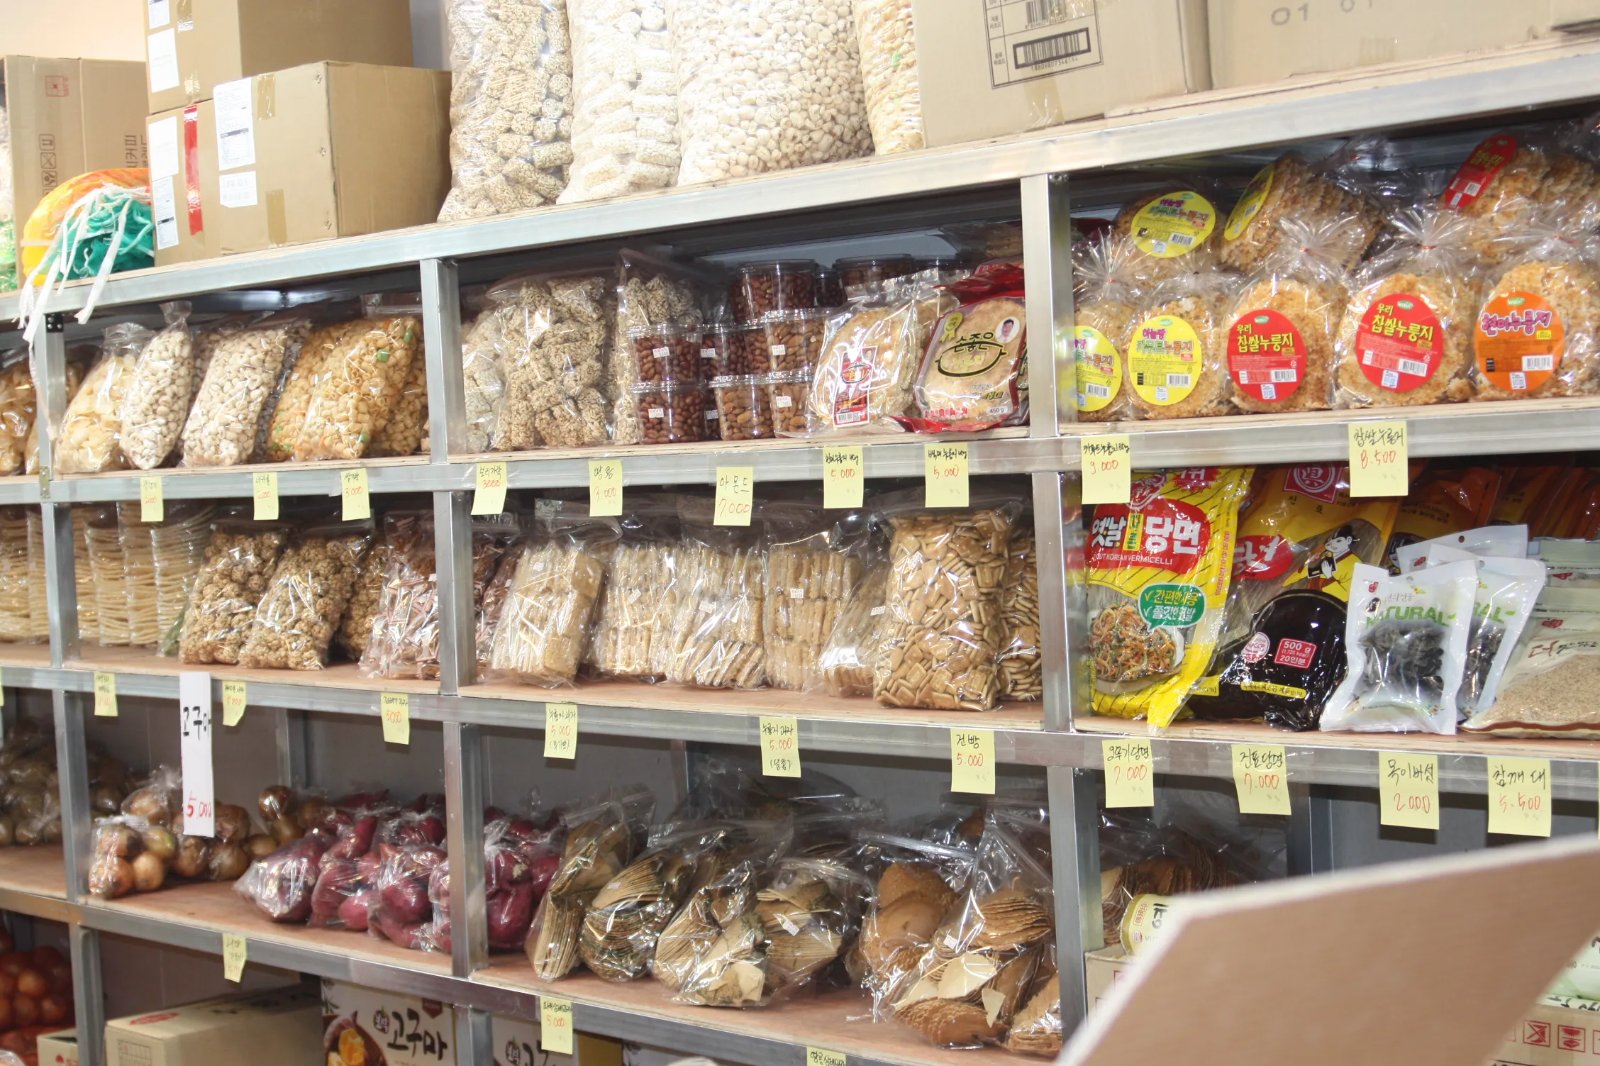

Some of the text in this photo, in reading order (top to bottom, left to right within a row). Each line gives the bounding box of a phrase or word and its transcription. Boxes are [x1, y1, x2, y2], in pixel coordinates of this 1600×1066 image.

[1377, 303, 1394, 316] 우리
[1237, 323, 1252, 334] 우리
[1371, 314, 1434, 342] 찹쌀누룽지
[1481, 308, 1553, 337] 현미누룽지
[1237, 332, 1294, 353] 찹쌀누룽지
[1091, 515, 1127, 549] 옛날
[1145, 515, 1201, 555] 당면
[1128, 554, 1173, 565] VERMICELLI
[1284, 641, 1302, 651] 500
[387, 1007, 448, 1061] 고구마
